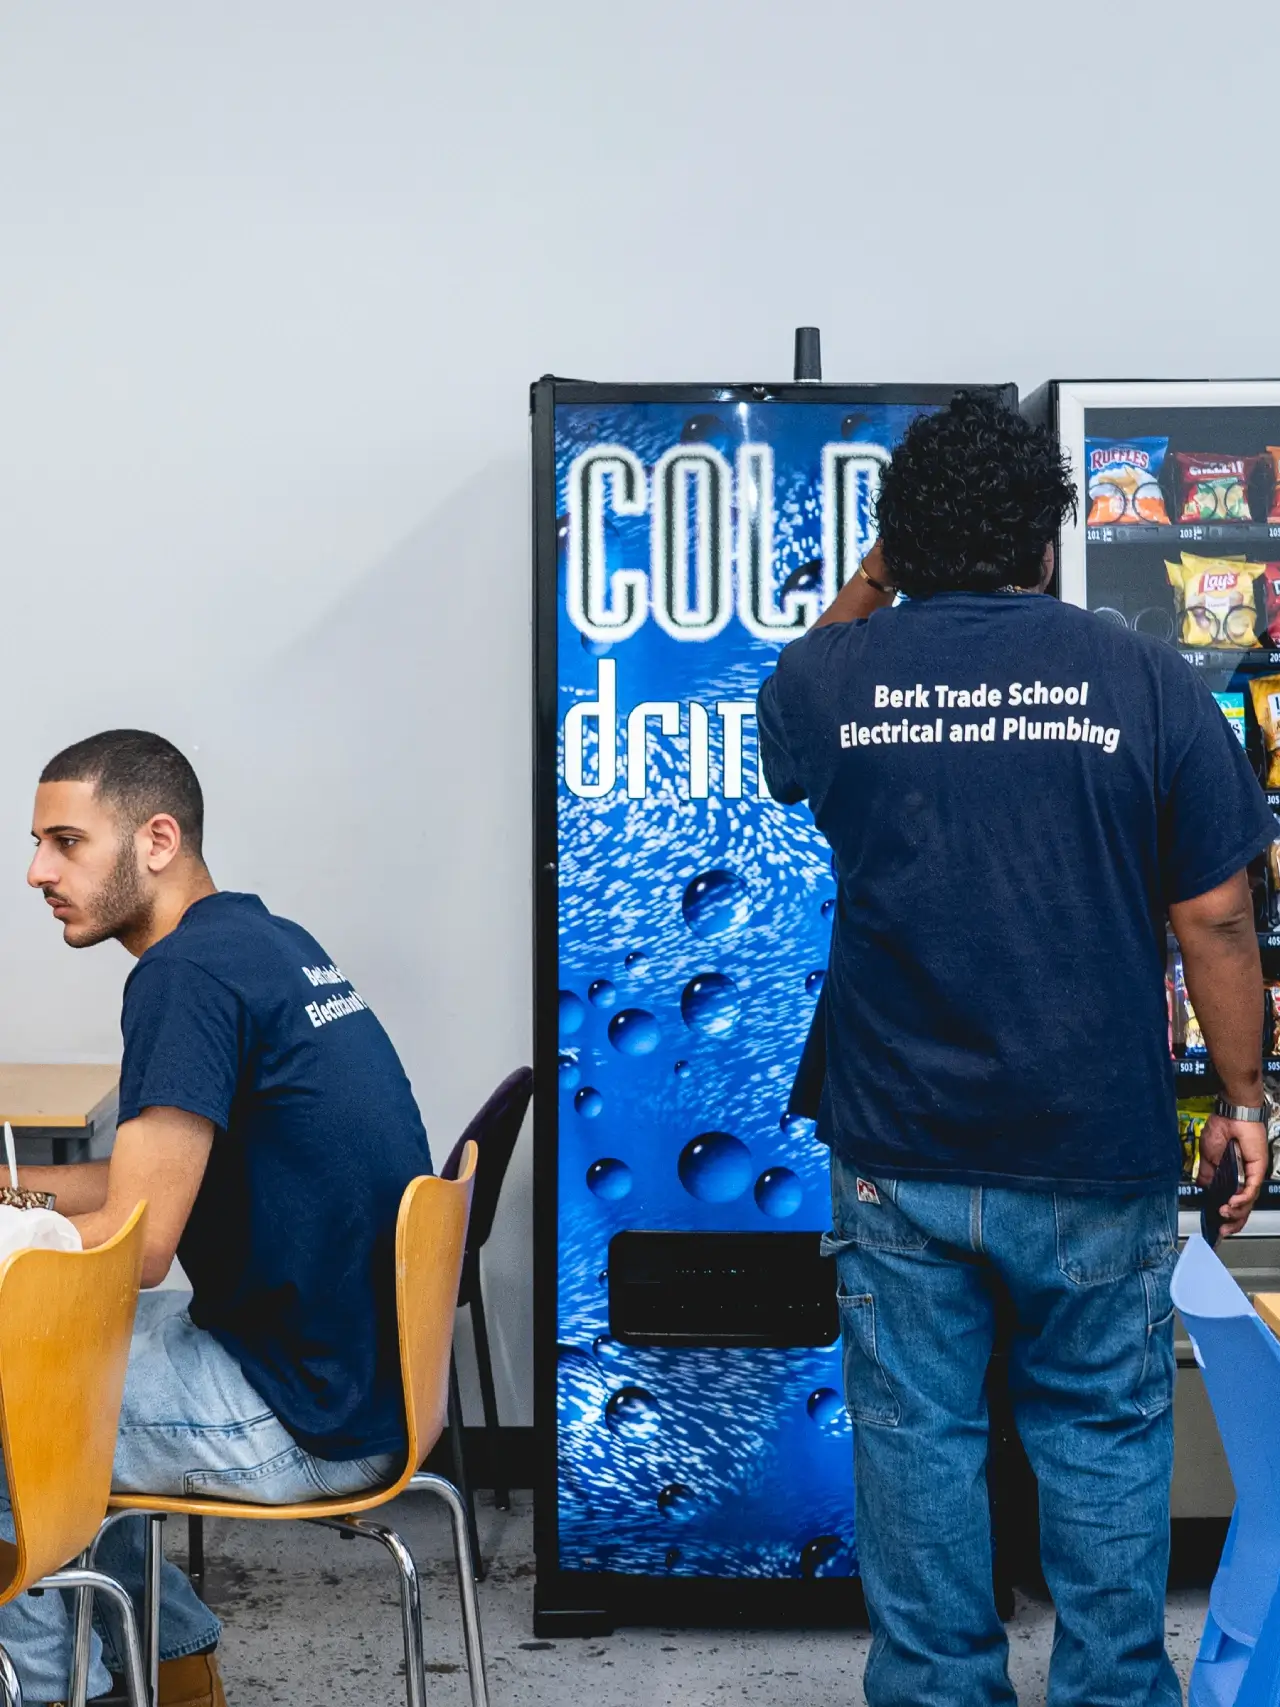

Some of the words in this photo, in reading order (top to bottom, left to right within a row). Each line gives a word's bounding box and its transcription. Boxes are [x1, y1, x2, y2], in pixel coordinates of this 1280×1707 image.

[1091, 448, 1149, 470] RUFFLES
[1087, 530, 1100, 540] 101
[1180, 529, 1193, 539] 103
[1203, 572, 1235, 592] Lay's
[874, 684, 931, 708] Berk
[934, 683, 1001, 708] Trade
[1008, 680, 1089, 707] School
[840, 718, 944, 749] Electrical
[949, 717, 996, 743] and
[1003, 716, 1121, 753] Plumbing
[1267, 795, 1280, 805] 305
[1267, 936, 1280, 946] 405
[1180, 1062, 1193, 1072] 503
[1267, 1062, 1280, 1071] 505
